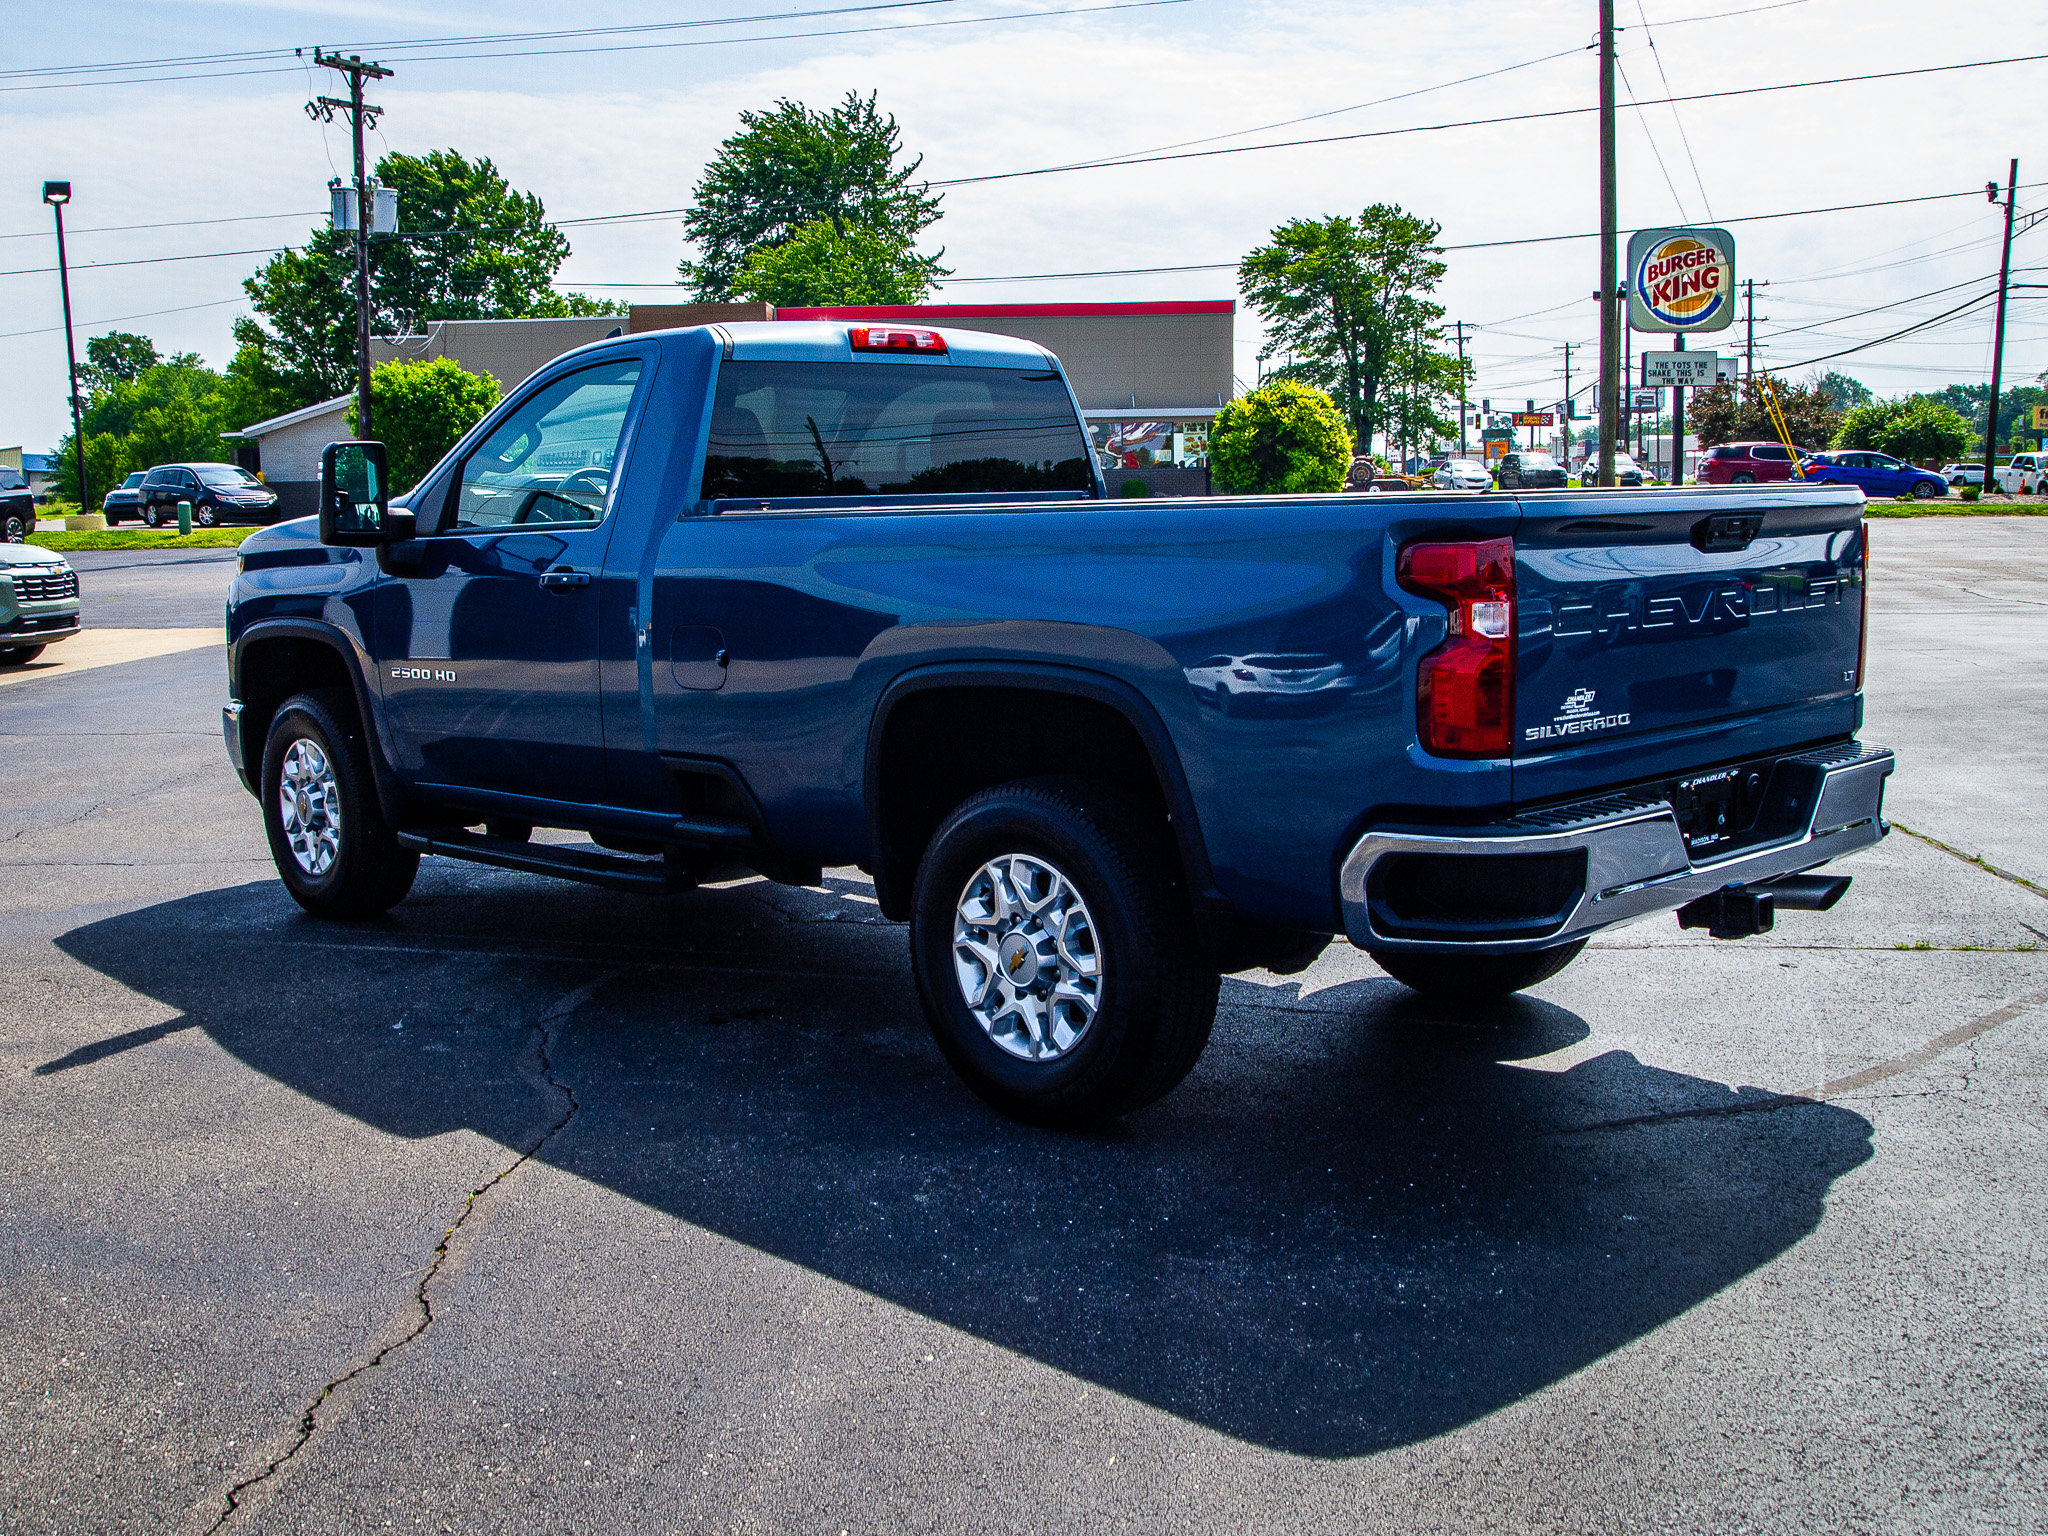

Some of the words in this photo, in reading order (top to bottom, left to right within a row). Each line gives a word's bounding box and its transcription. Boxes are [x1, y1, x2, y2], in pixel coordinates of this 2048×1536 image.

[1648, 248, 1716, 284] BURGER
[1652, 266, 1720, 308] KING
[1655, 361, 1669, 369] THE
[1672, 361, 1691, 369] TOTS
[1694, 361, 1708, 369] THE
[1648, 369, 1671, 377] SHAKE
[1676, 369, 1692, 377] THIS
[1697, 369, 1705, 377] IS
[1662, 377, 1675, 385] THE
[1678, 377, 1695, 385] WAY
[1553, 577, 1850, 637] CHEVROLET
[391, 667, 432, 680] 2500
[435, 669, 457, 682] HD
[1843, 670, 1855, 682] LT
[1525, 713, 1631, 741] SILVERADO
[1692, 773, 1727, 786] CHANDLER
